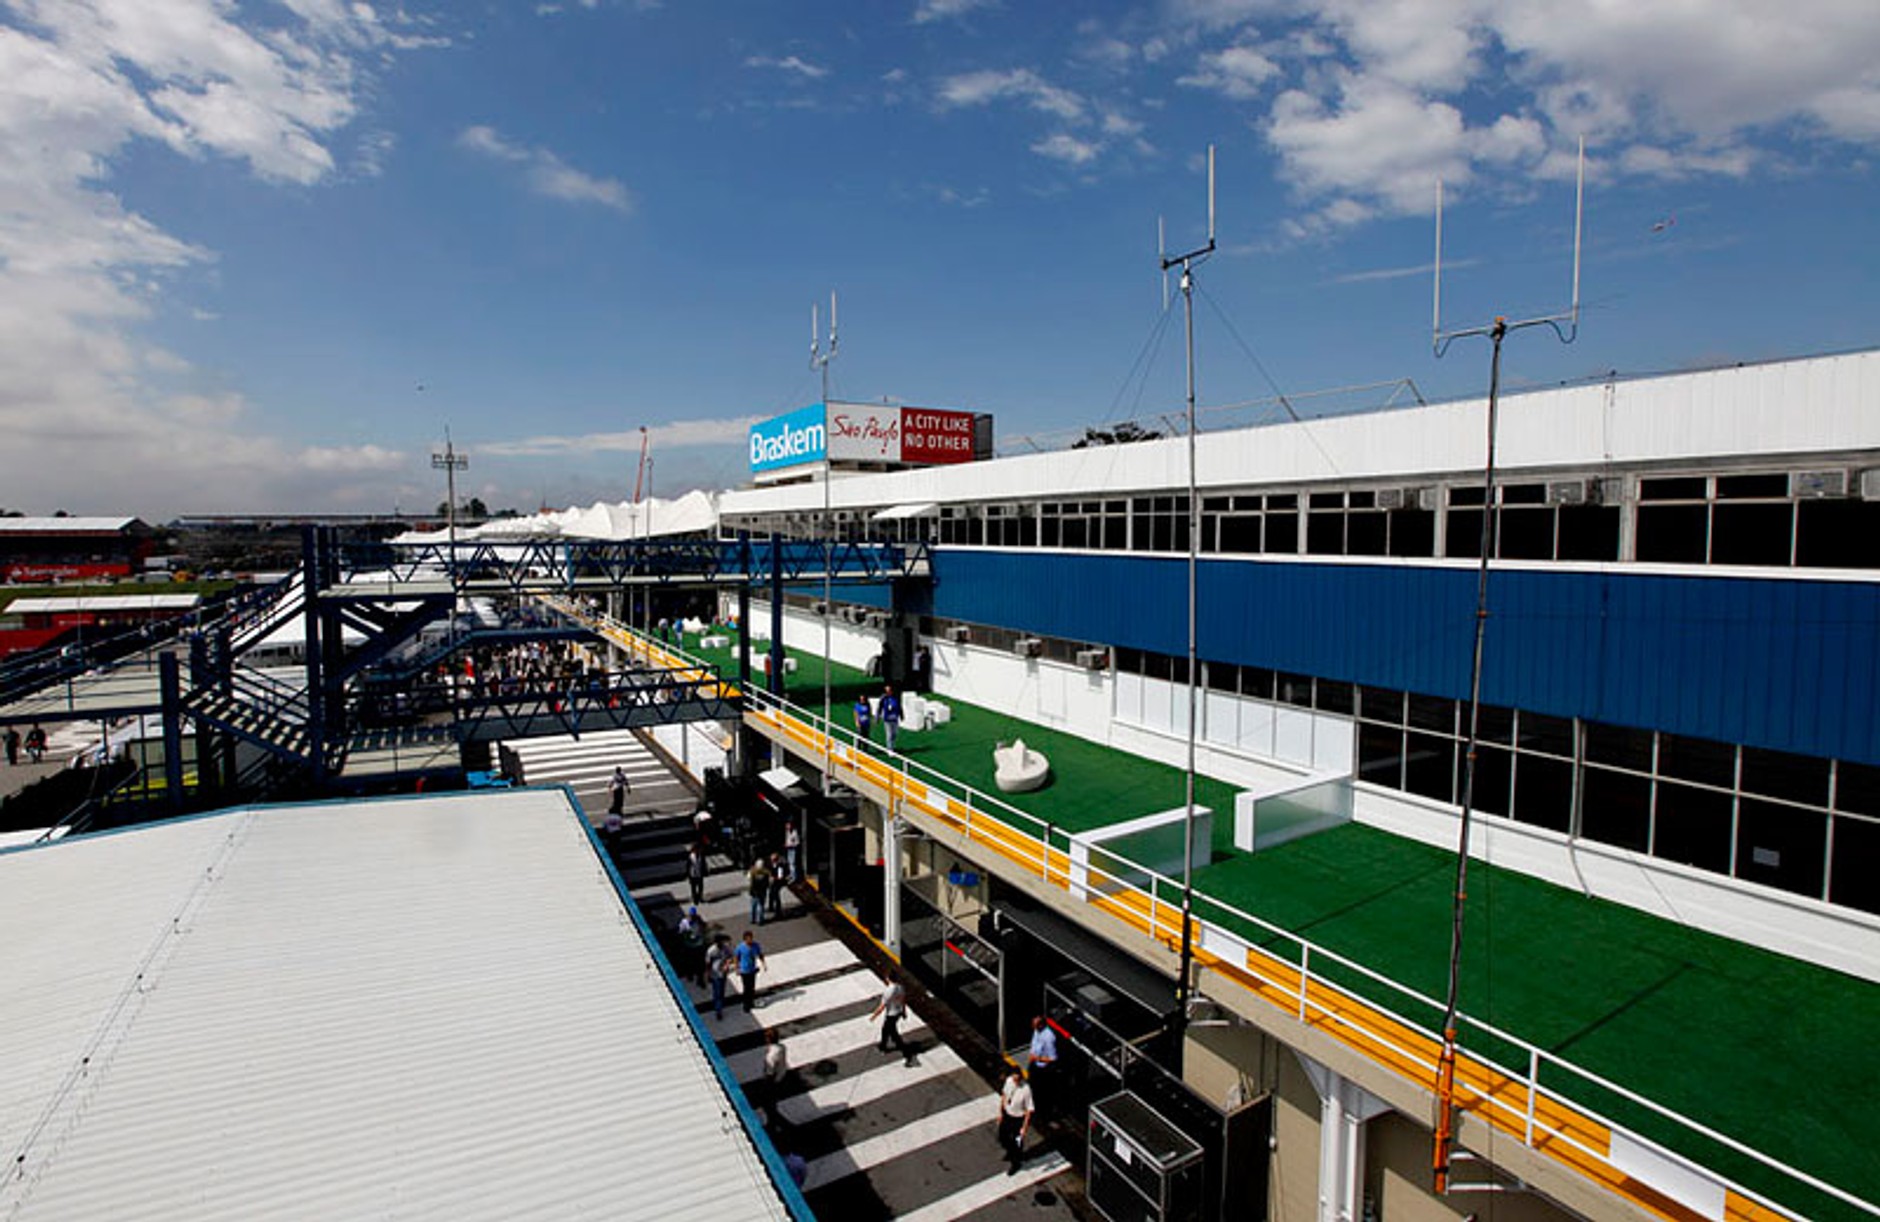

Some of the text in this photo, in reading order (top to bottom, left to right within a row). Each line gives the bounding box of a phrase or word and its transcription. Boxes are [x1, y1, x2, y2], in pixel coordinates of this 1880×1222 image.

[905, 413, 970, 432] A CITY LIKE
[750, 423, 825, 465] Braskem
[904, 432, 970, 450] NO OTHER
